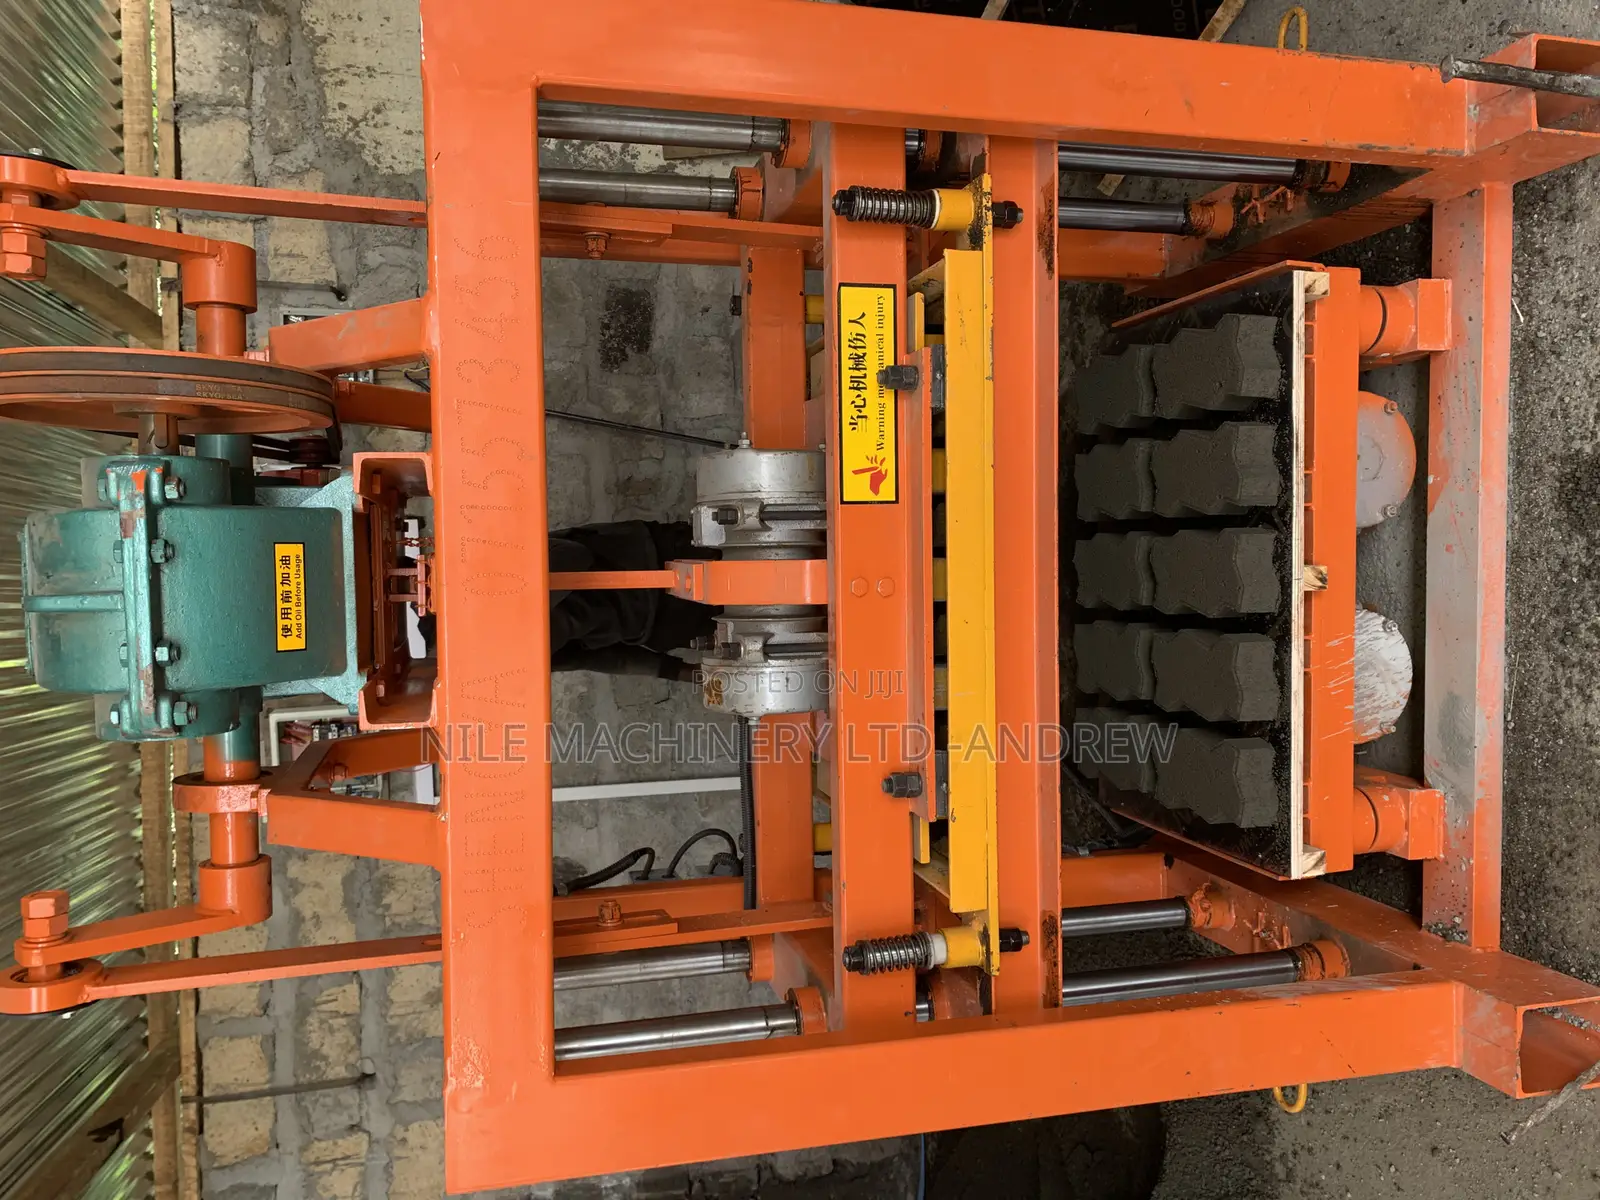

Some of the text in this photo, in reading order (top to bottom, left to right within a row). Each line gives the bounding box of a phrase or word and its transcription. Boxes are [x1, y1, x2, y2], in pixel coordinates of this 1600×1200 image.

[847, 311, 868, 433] 当心机械伤人
[876, 294, 887, 451] Warning meanical injury
[279, 555, 292, 638] 使用前加油
[294, 554, 303, 579] Usage
